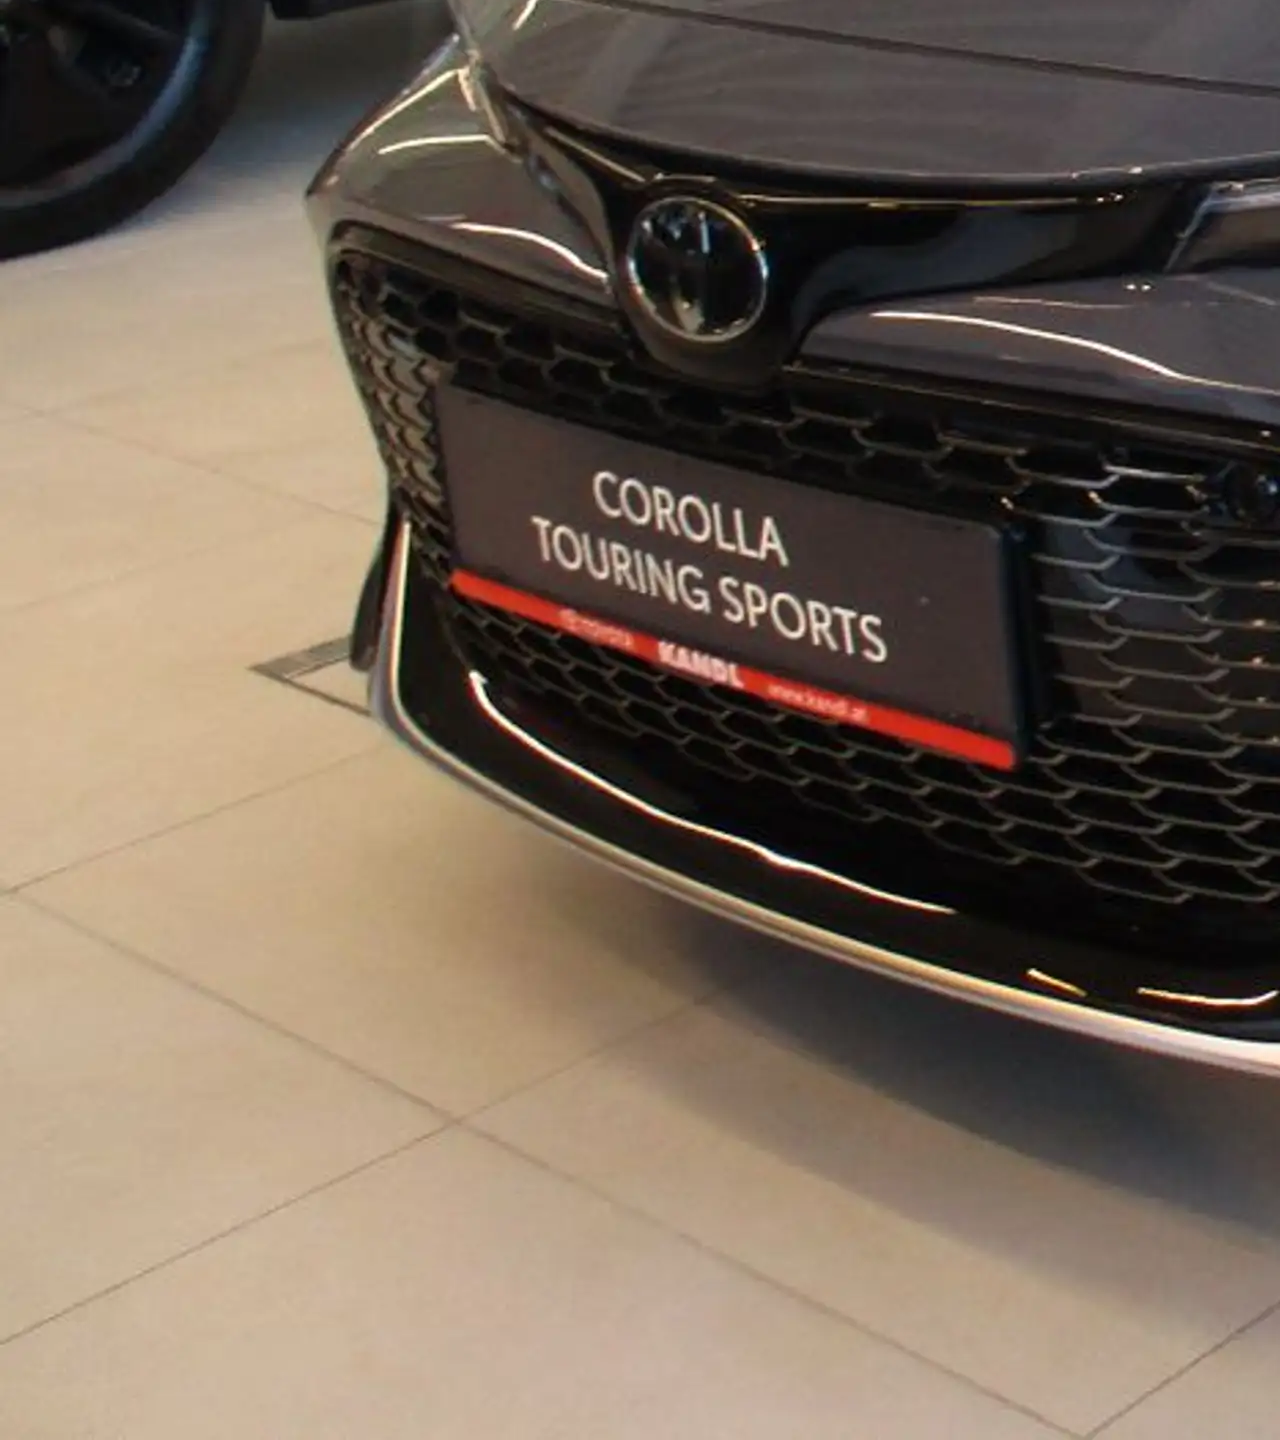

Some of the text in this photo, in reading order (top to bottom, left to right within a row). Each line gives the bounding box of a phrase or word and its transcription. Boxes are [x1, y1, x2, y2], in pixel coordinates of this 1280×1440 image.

[593, 470, 789, 566] COROLLA
[531, 516, 710, 613] TOURING
[718, 575, 888, 663] SPORTS
